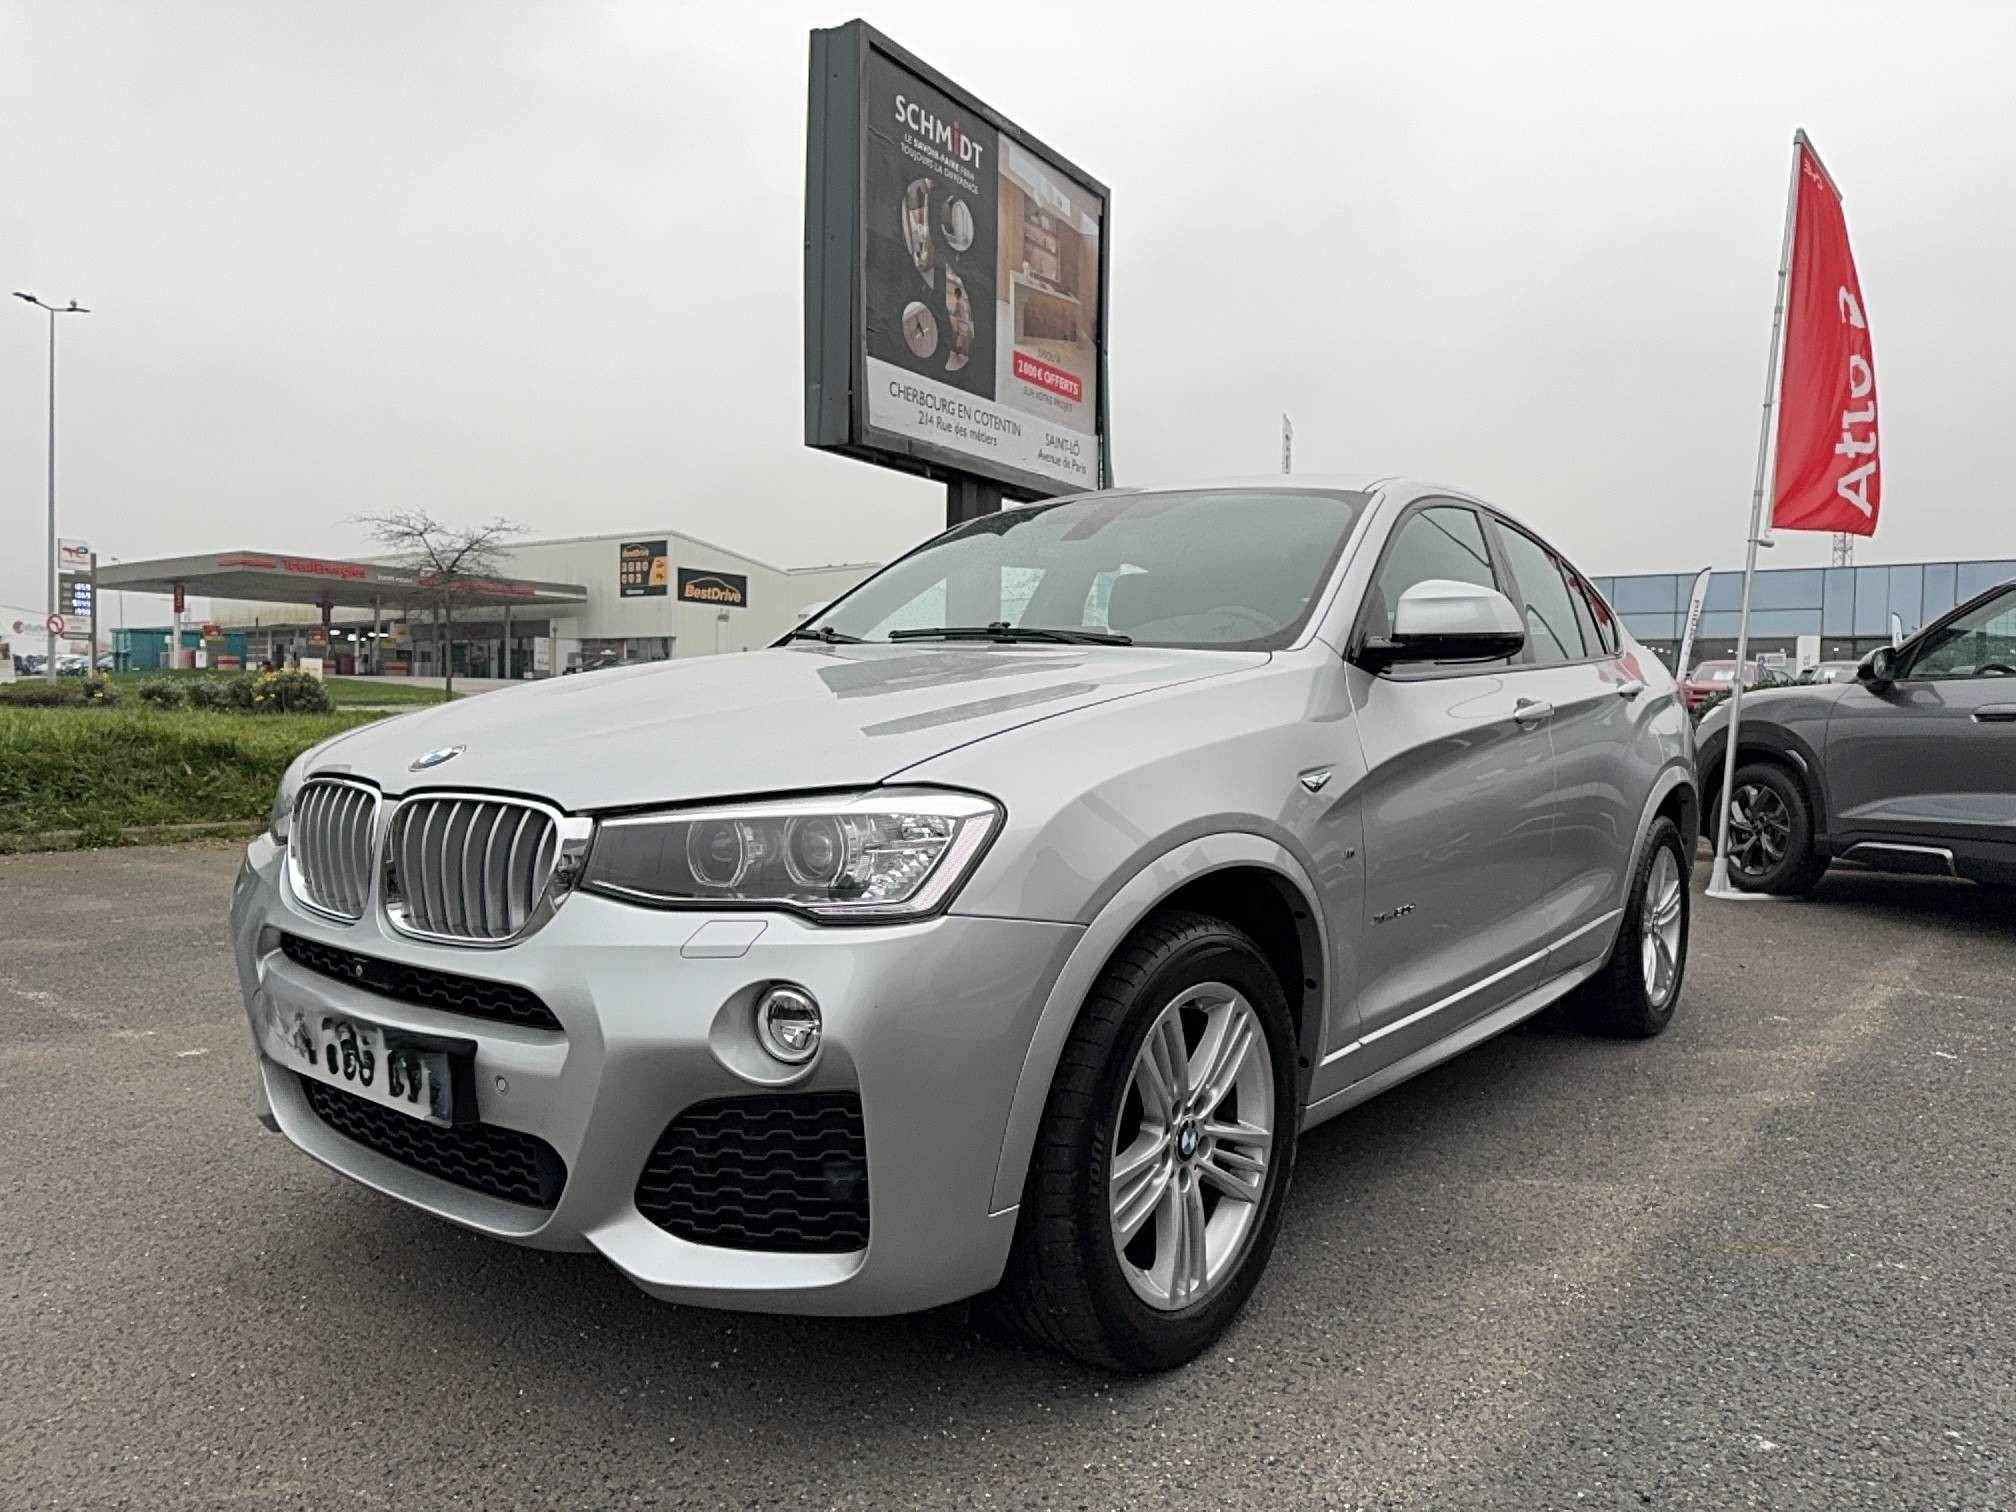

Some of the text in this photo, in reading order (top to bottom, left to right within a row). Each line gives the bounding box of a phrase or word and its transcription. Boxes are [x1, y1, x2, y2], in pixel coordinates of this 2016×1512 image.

[1043, 371, 1079, 395] OFFERTS
[889, 381, 1021, 437] CHERBOURG EN COTENTIN
[918, 410, 935, 426] 214
[936, 415, 953, 433] Rue
[954, 421, 968, 438] des
[1038, 448, 1087, 475] Avenue de Paris
[683, 582, 742, 603] BestDrive
